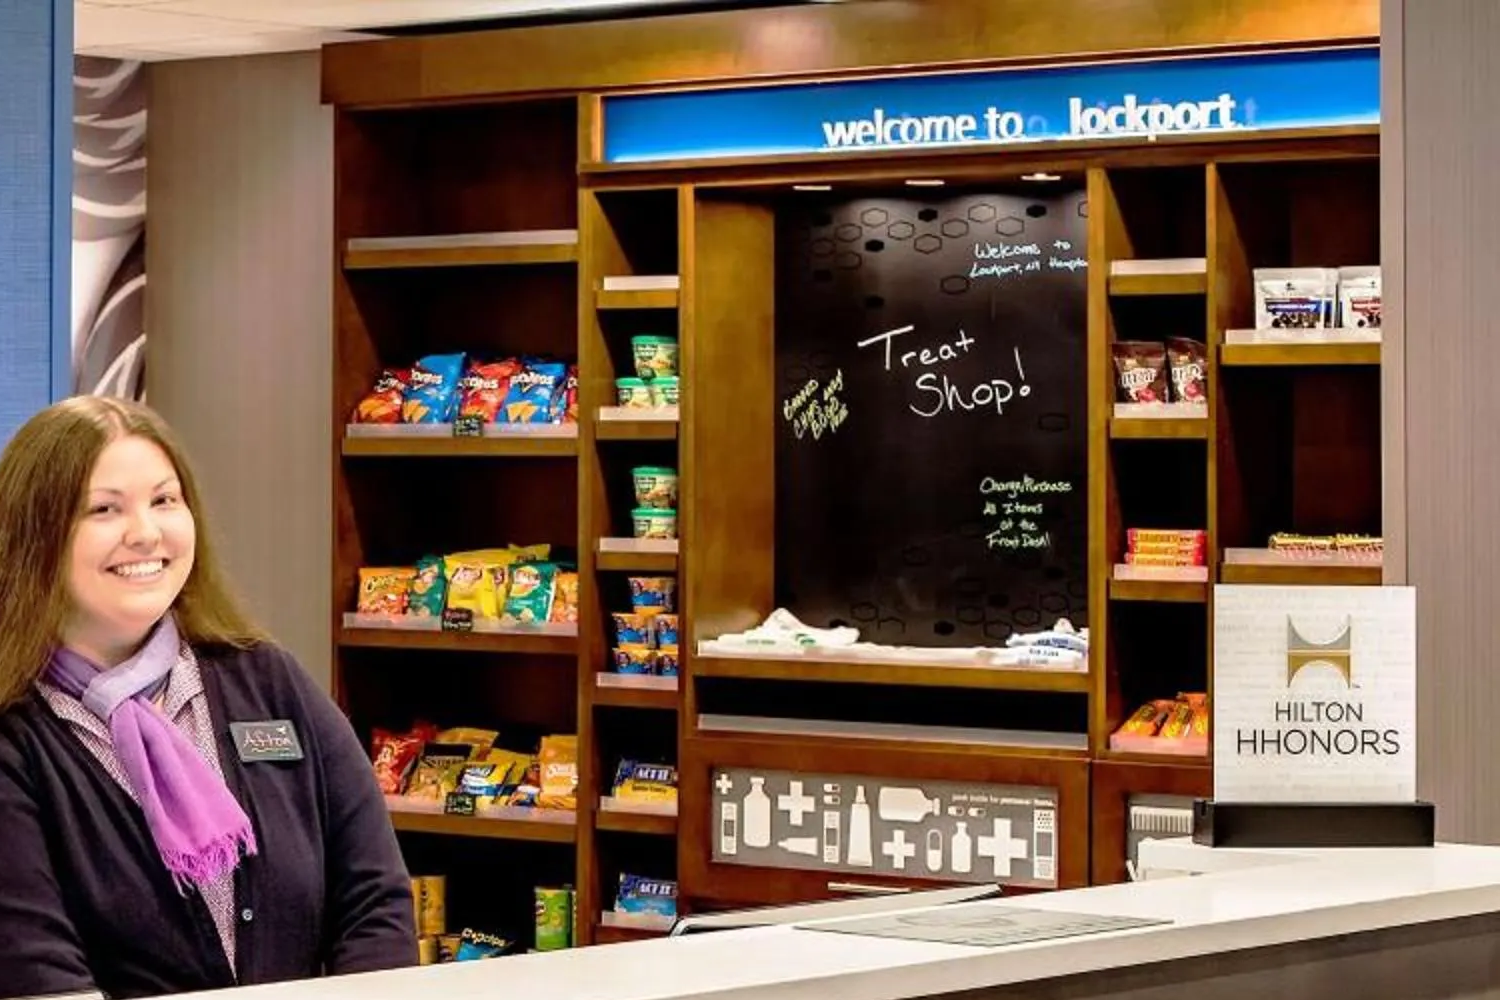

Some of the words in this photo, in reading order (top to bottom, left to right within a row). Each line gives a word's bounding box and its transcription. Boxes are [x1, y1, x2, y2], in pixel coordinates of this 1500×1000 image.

[822, 108, 977, 146] welcome
[984, 106, 1024, 141] to
[1069, 93, 1236, 142] lockport
[974, 242, 1041, 259] Welcome
[857, 325, 975, 371] Treat
[909, 346, 1031, 417] Shop!
[1275, 702, 1363, 722] HILTON
[1237, 729, 1401, 755] HHONORS
